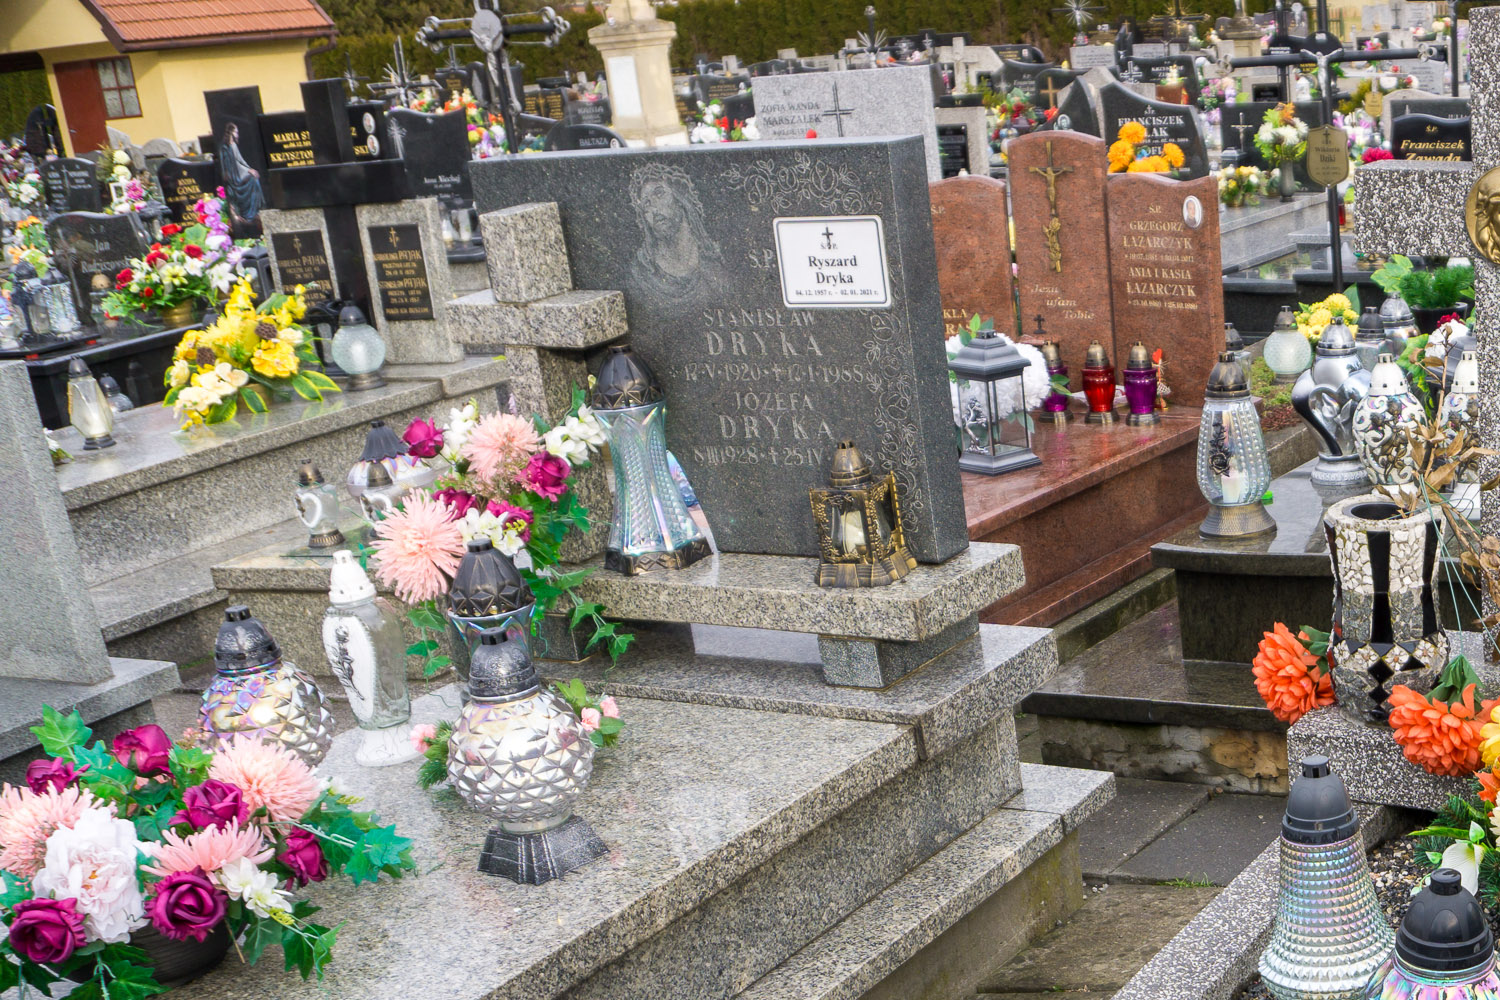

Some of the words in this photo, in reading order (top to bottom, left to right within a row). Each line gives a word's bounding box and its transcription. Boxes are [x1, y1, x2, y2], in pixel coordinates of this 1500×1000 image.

[761, 104, 786, 113] ZOFIA
[787, 101, 820, 110] WANDA
[273, 132, 300, 143] MARIA
[1400, 139, 1465, 150] Franciszek
[1129, 220, 1184, 233] GRZEGORZ
[808, 254, 858, 270] Ryszard
[816, 271, 854, 287] Dryka
[1128, 266, 1152, 278] ANIA
[1161, 268, 1192, 280] KASIA
[702, 307, 816, 328] STANISŁAW
[703, 330, 824, 357] DRYKA
[735, 387, 814, 412] JÓZEFA
[718, 413, 835, 441] DRYKA
